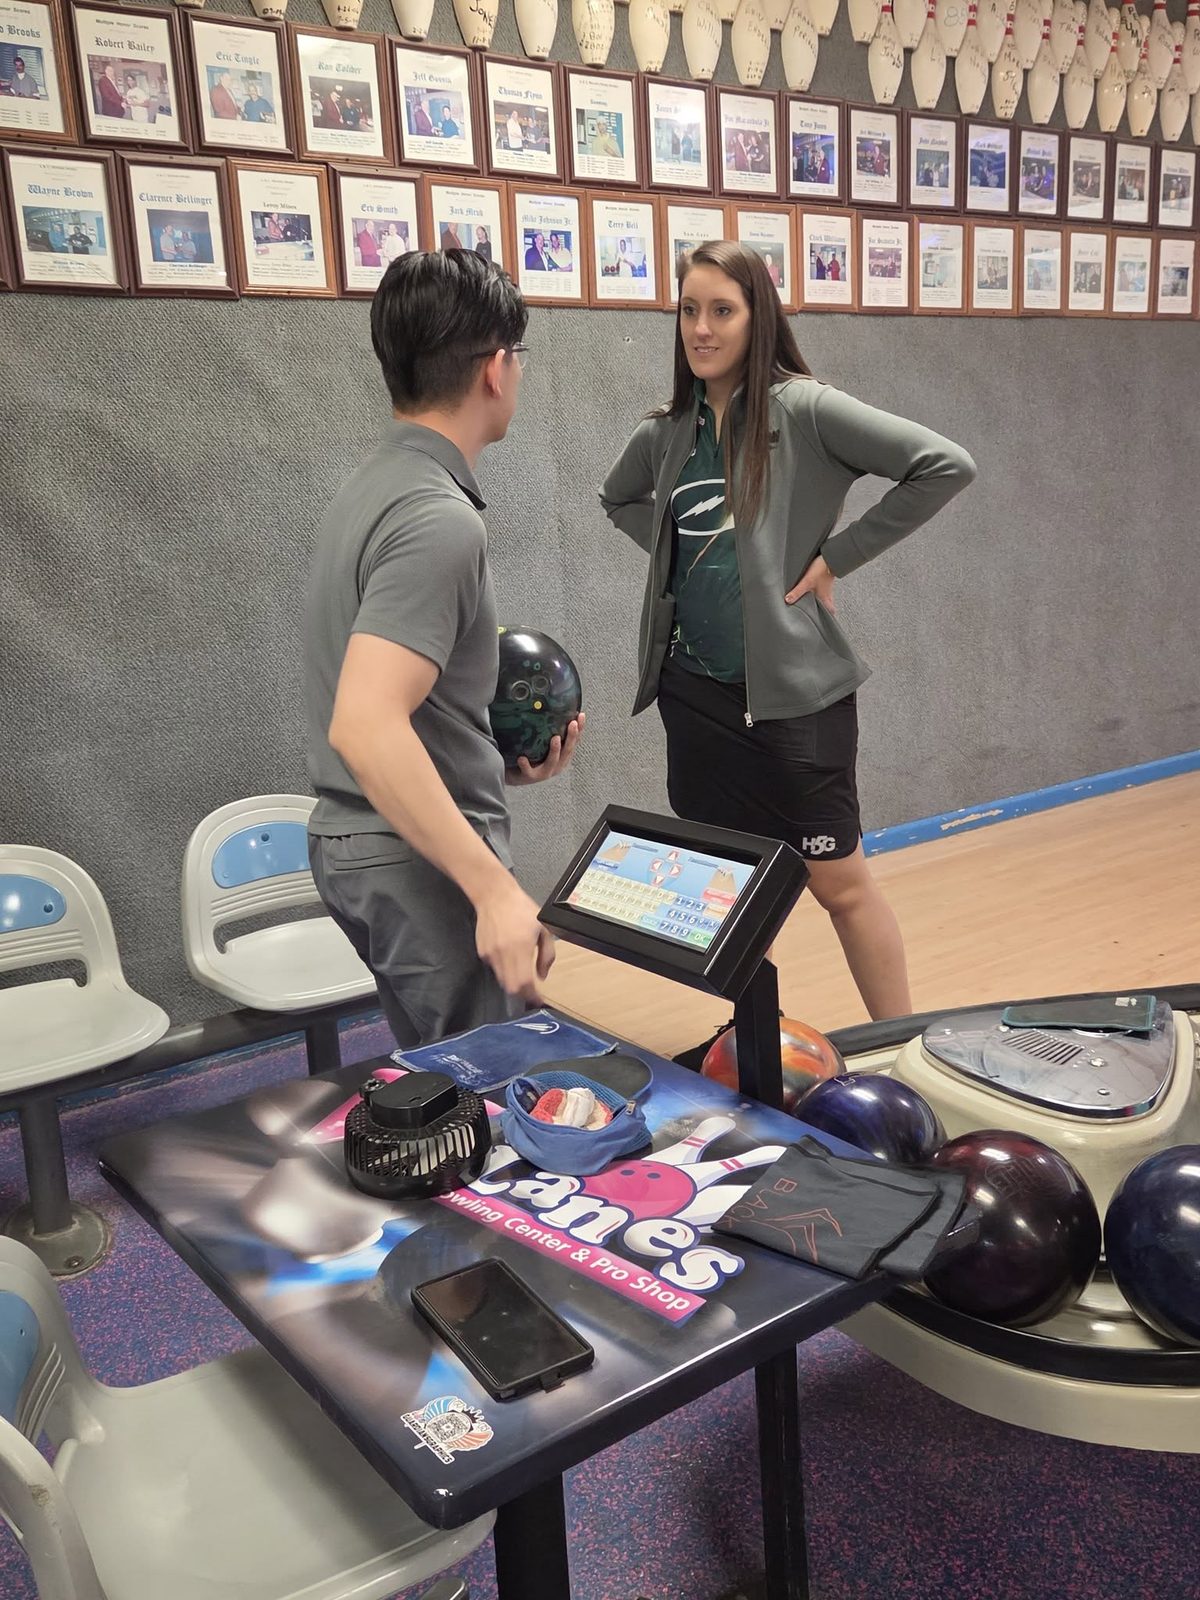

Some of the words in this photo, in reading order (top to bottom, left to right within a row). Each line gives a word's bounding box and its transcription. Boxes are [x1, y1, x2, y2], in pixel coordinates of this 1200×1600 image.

[6, 25, 41, 38] Brooks
[94, 36, 124, 49] Robert
[27, 184, 60, 196] Wayne
[63, 186, 94, 198] Brown
[139, 192, 173, 203] Clarence
[694, 933, 706, 942] OK
[439, 1190, 504, 1223] owling
[503, 1217, 571, 1251] Center
[569, 1247, 591, 1263] &
[589, 1258, 629, 1281] Pro
[628, 1275, 691, 1311] Shop
